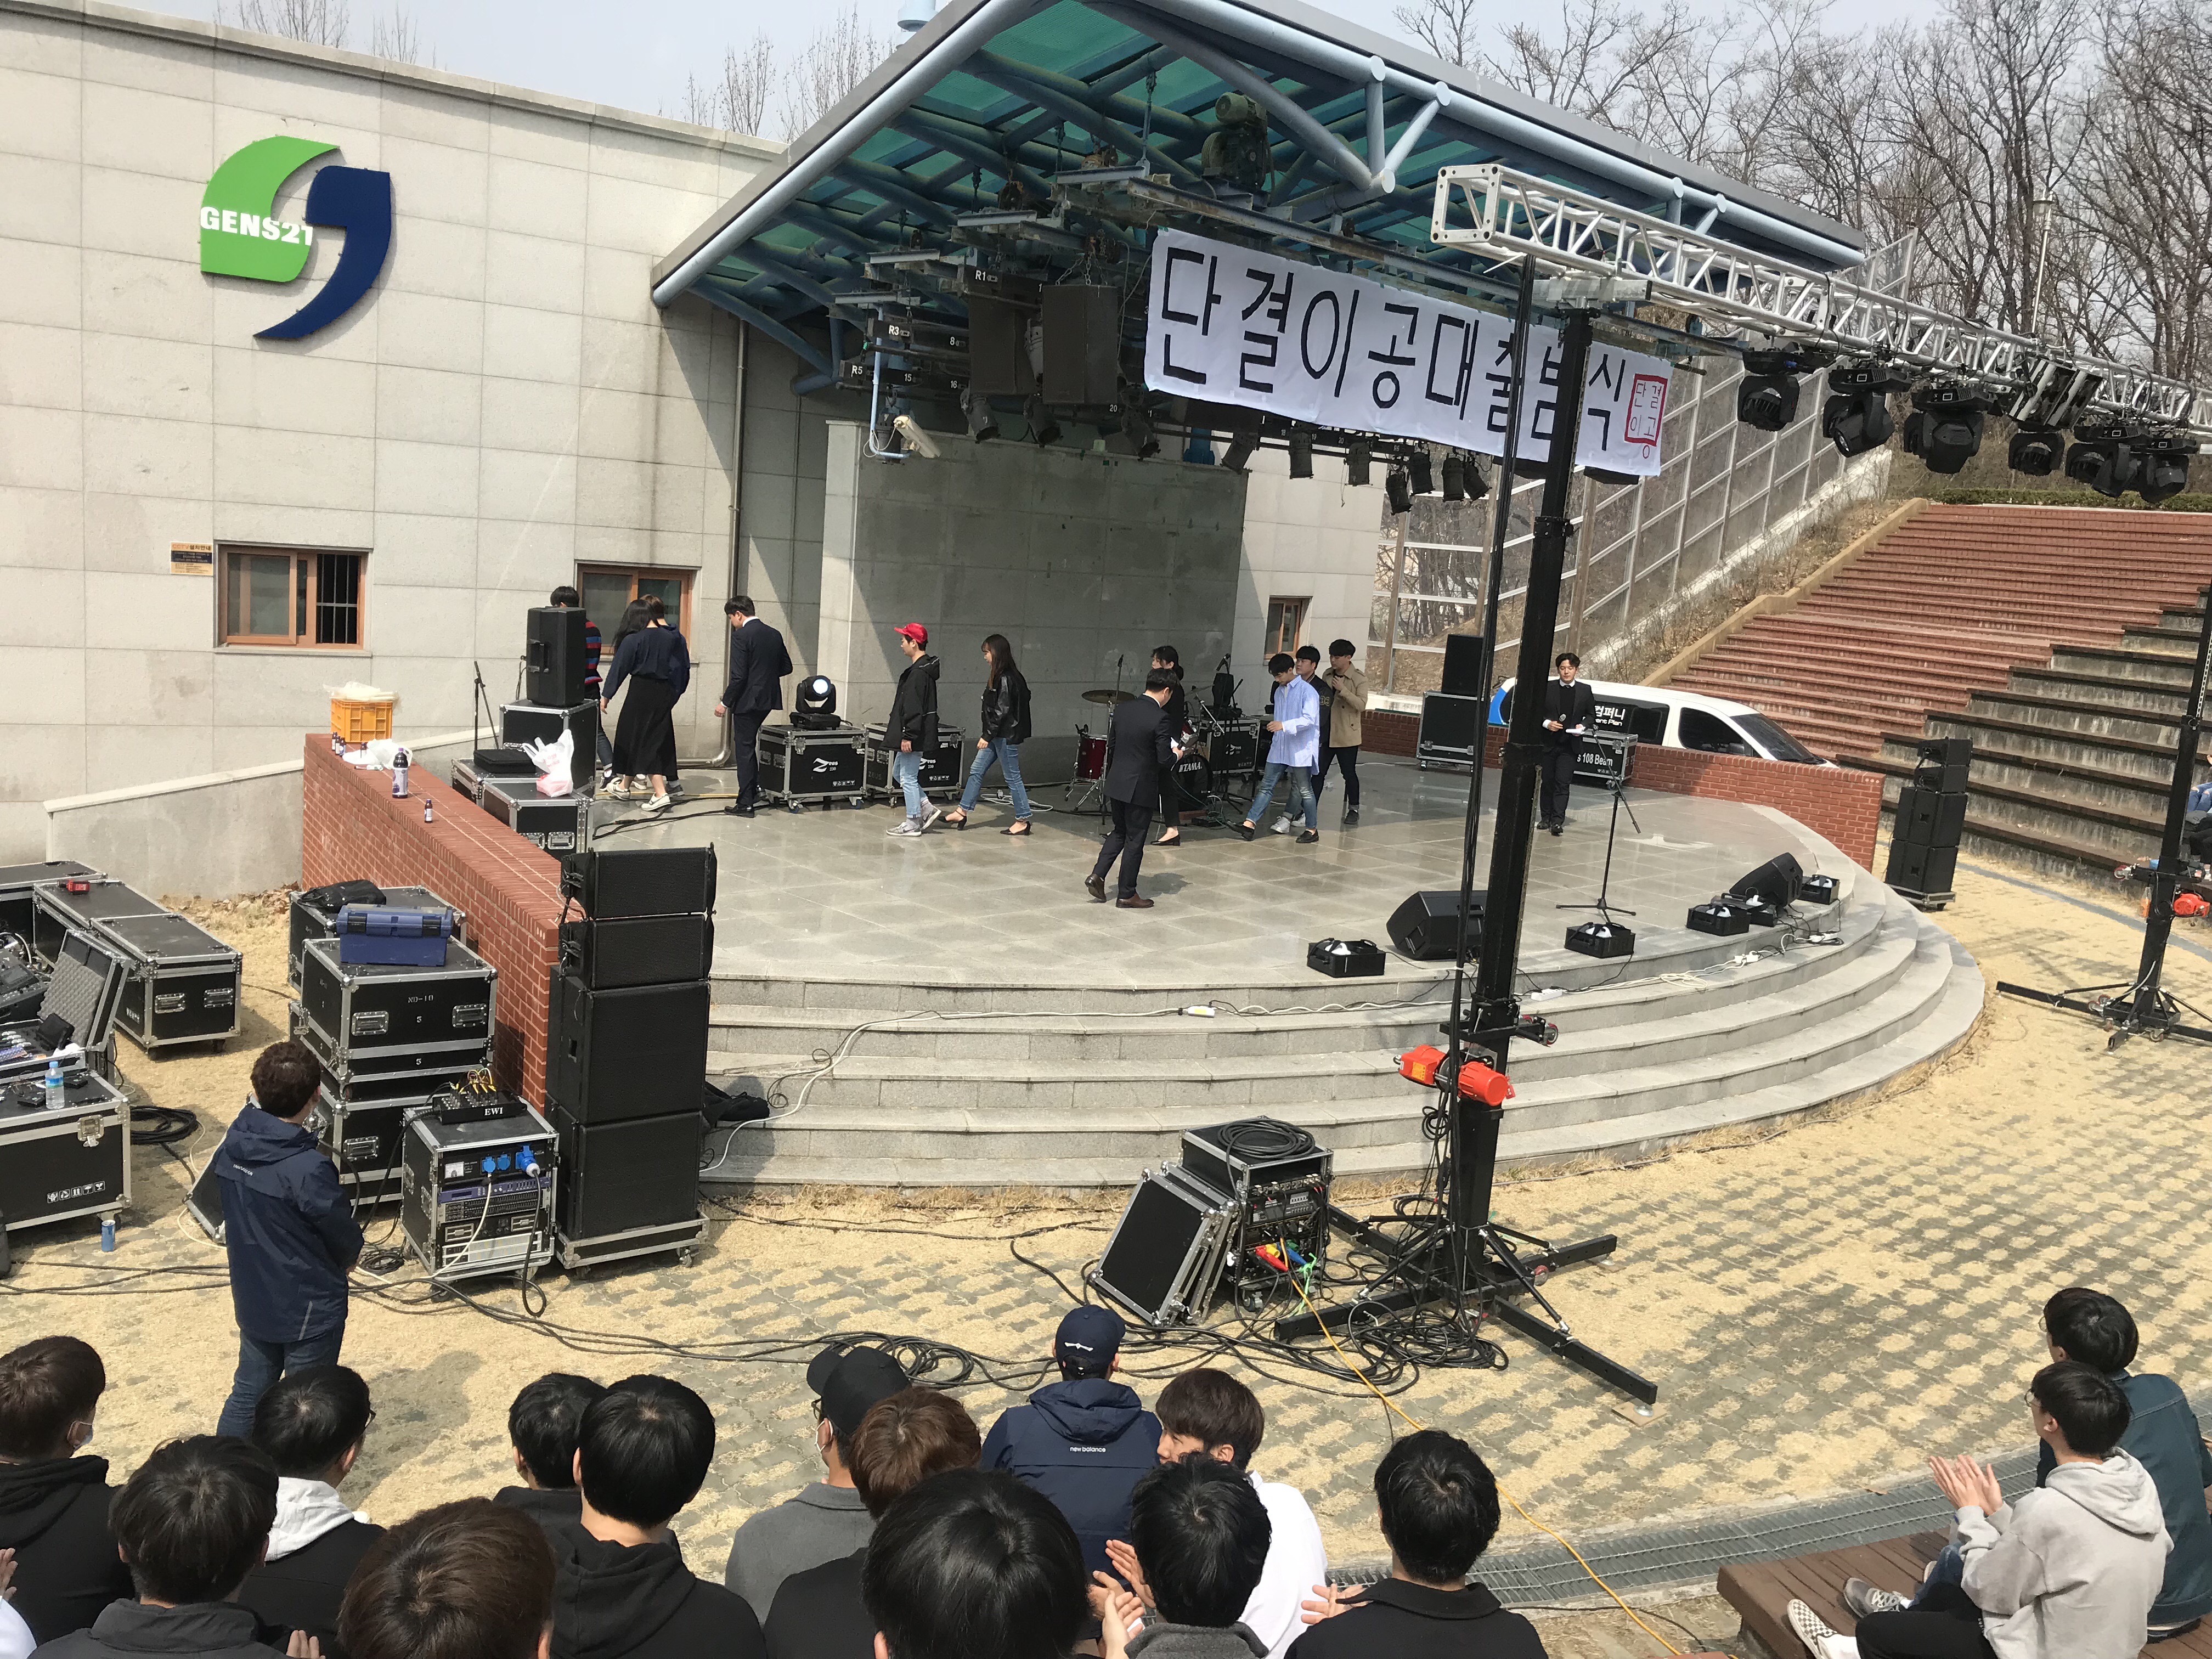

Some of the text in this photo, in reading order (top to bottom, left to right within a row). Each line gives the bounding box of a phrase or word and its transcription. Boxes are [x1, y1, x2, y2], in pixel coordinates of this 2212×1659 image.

[200, 206, 313, 246] GENS21
[975, 269, 986, 281] R1
[888, 324, 900, 336] R3
[950, 336, 955, 346] 8
[851, 365, 863, 376] R5
[904, 373, 912, 382] 15
[950, 380, 957, 388] 16
[1109, 404, 1118, 412] 20
[1582, 752, 1594, 764] 108
[1183, 762, 1201, 772] TAMA
[484, 1107, 503, 1116] EWI
